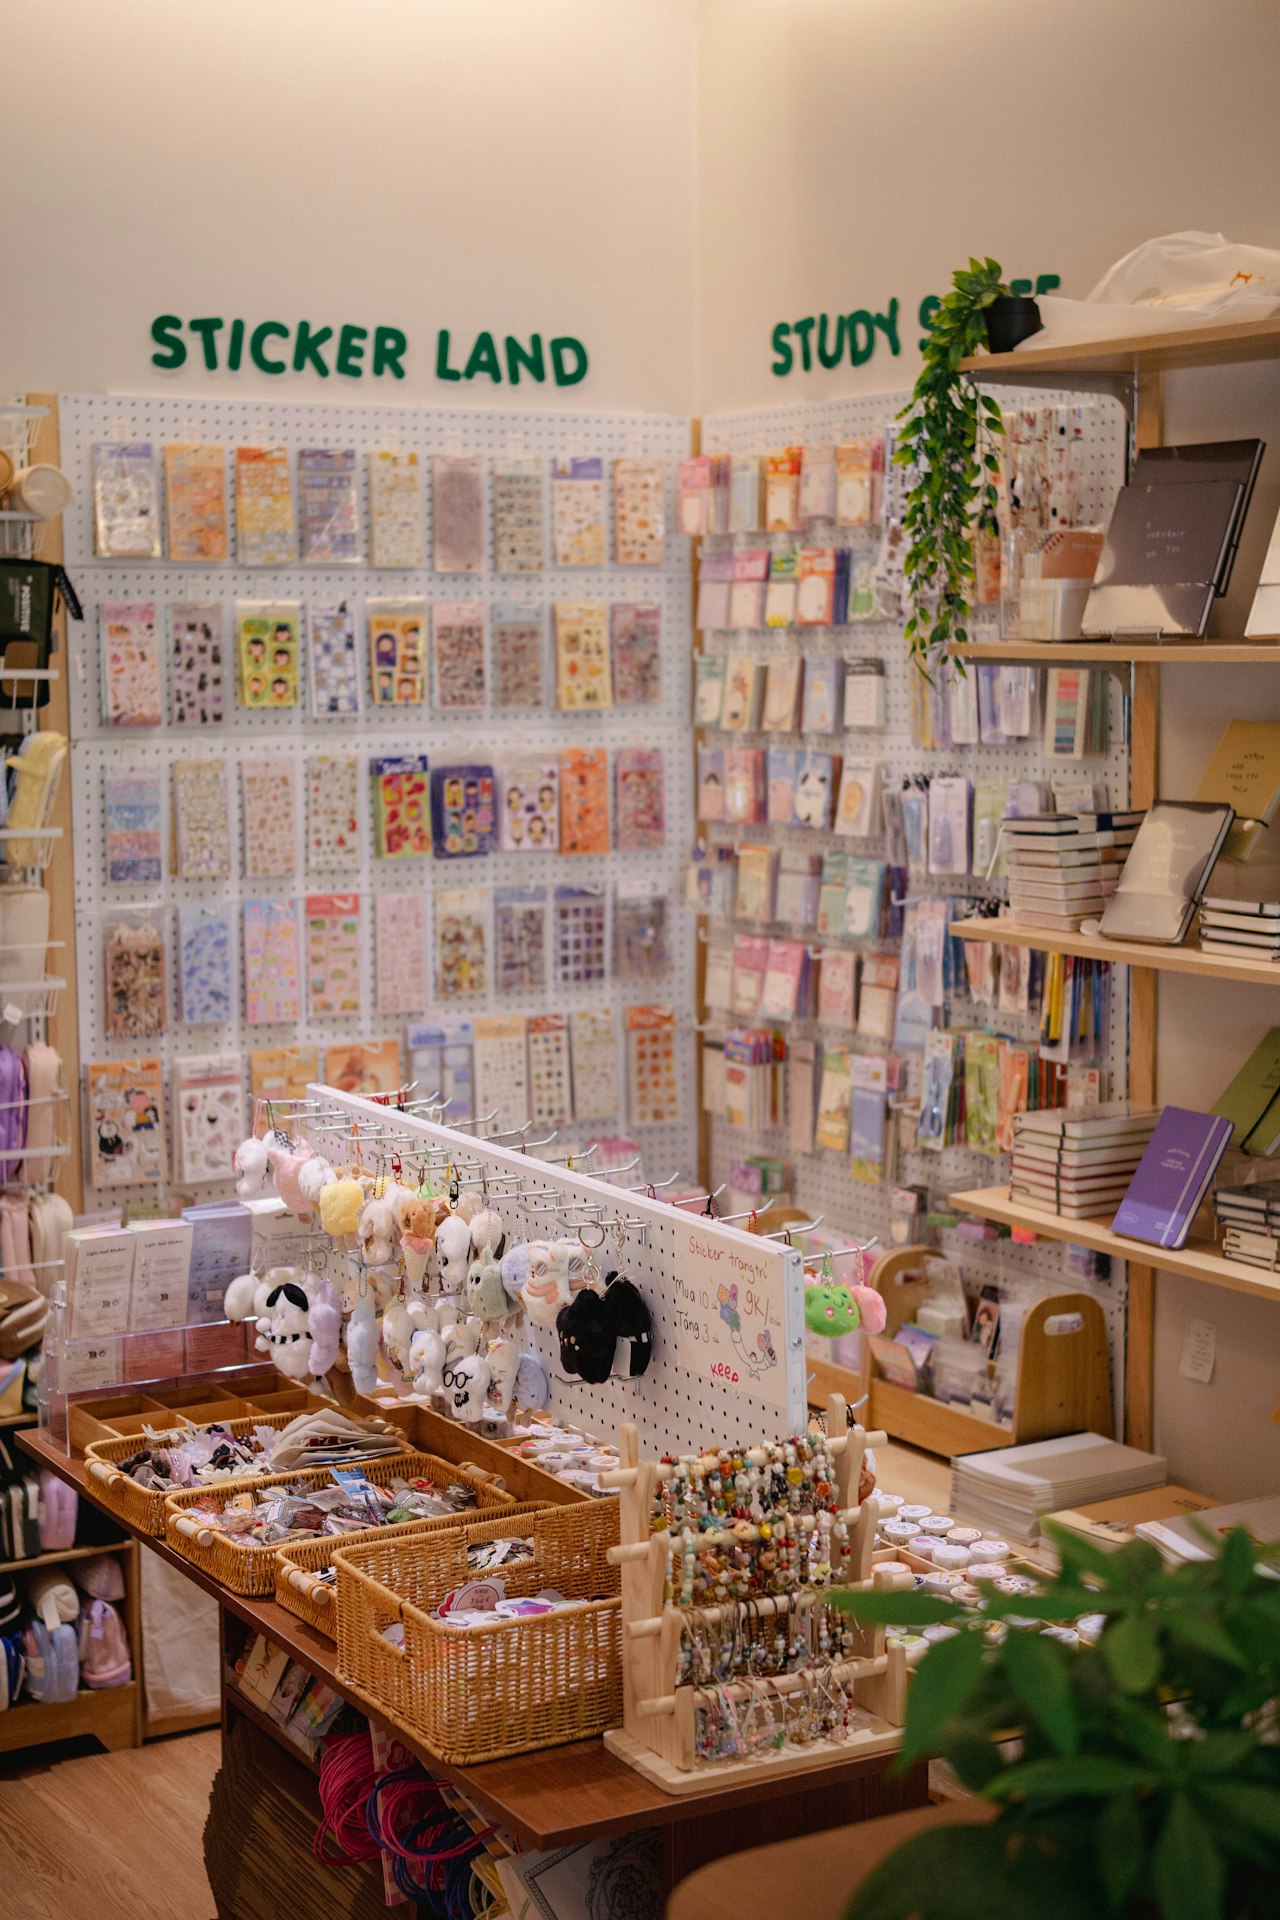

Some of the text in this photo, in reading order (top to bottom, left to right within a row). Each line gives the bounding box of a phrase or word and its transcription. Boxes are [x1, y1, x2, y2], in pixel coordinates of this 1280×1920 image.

[771, 297, 901, 377] STUDY
[151, 314, 588, 387] STICKER LAND
[688, 1235, 725, 1261] Sticker
[675, 1279, 696, 1303] Mua
[702, 1323, 710, 1344] 3
